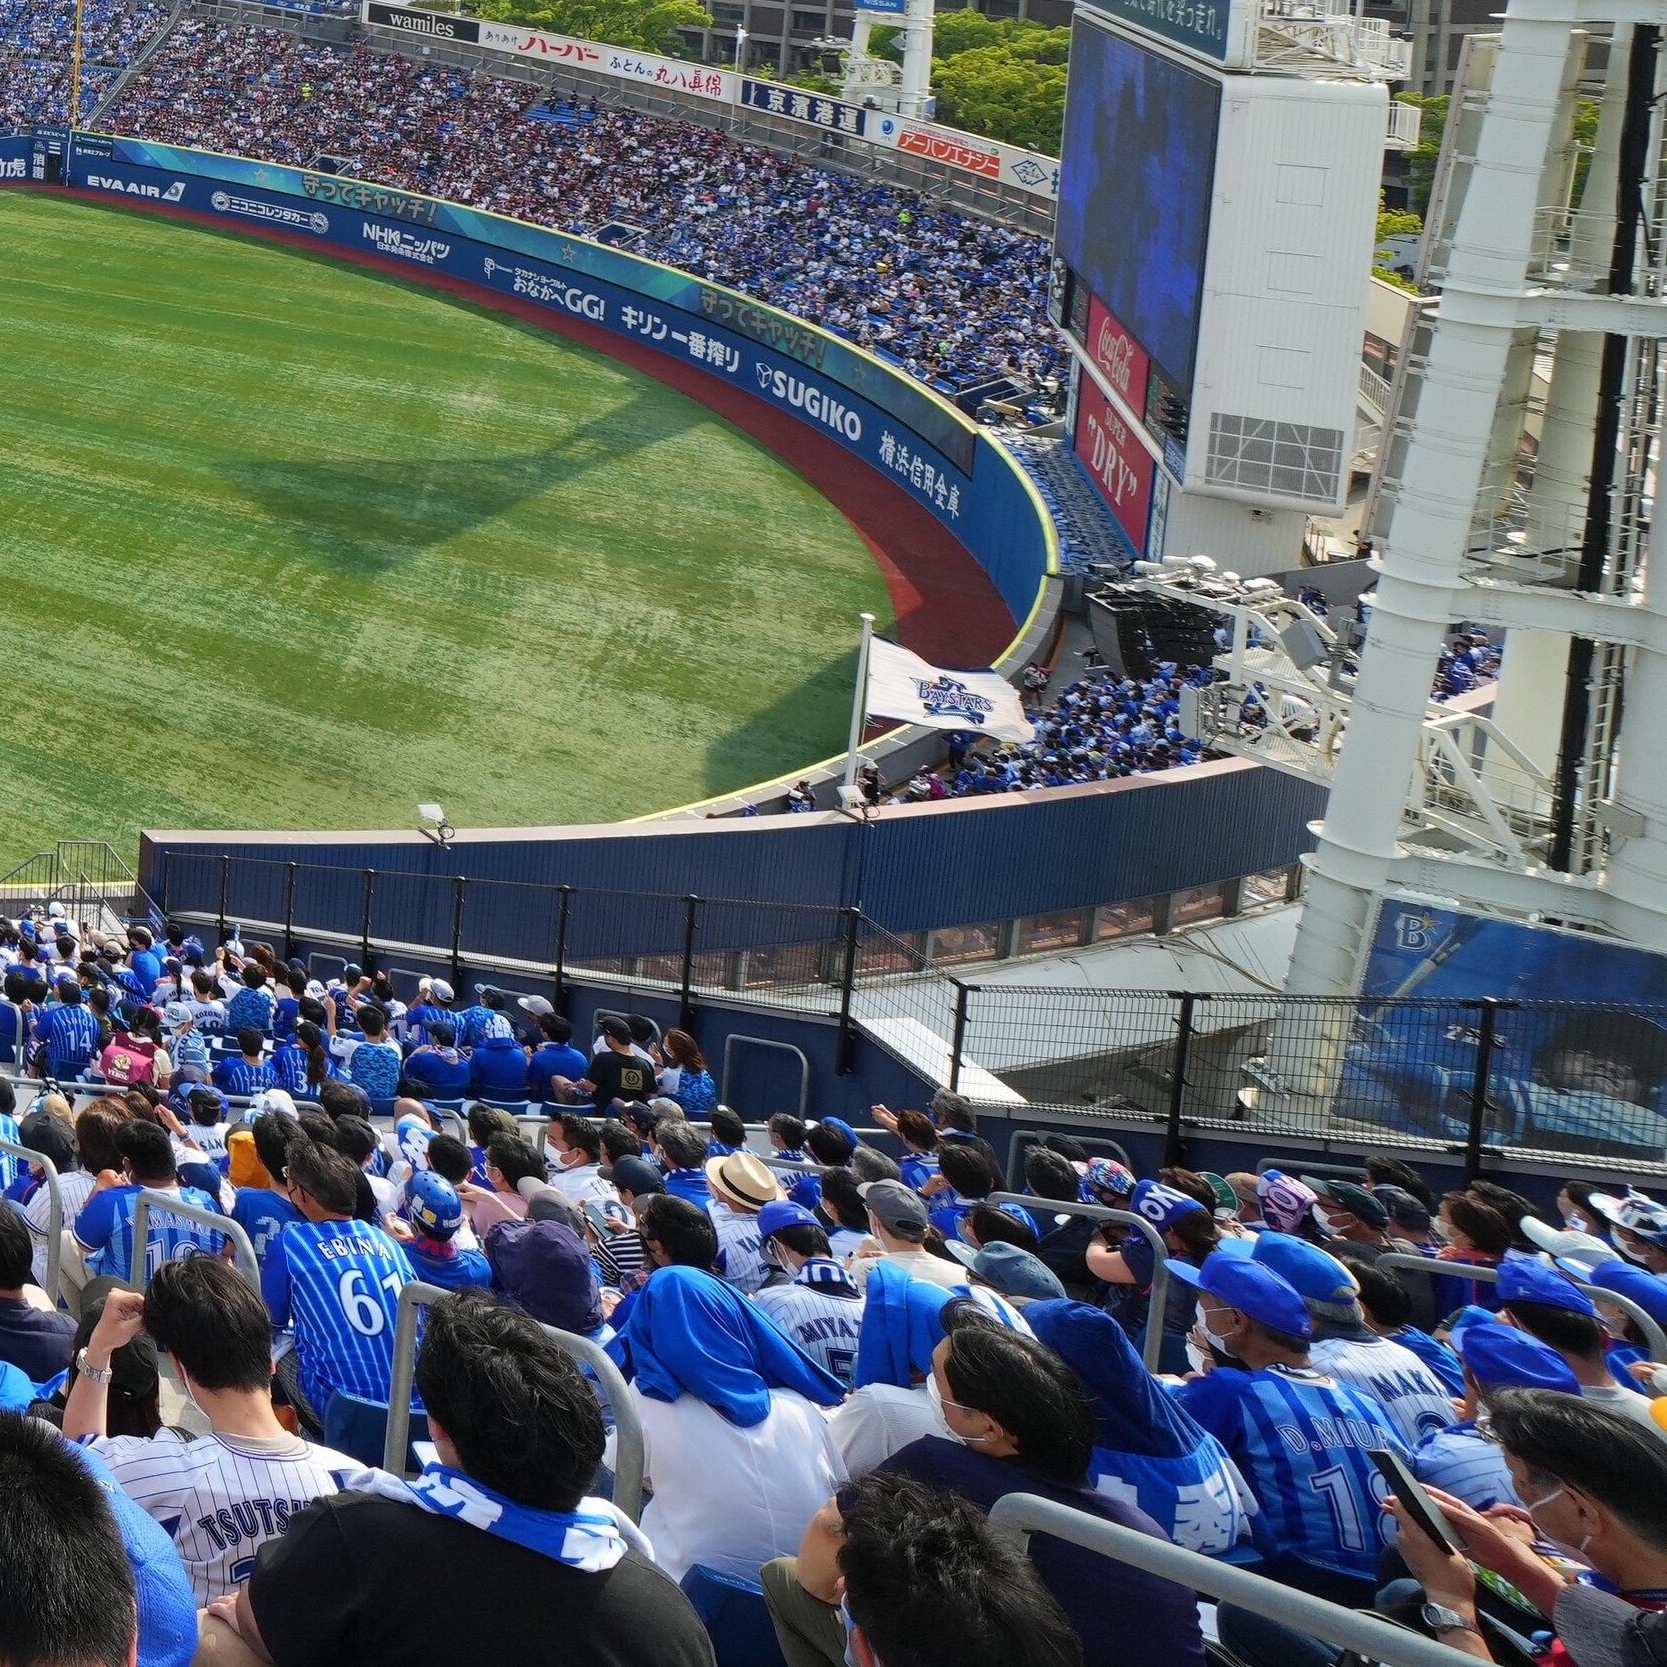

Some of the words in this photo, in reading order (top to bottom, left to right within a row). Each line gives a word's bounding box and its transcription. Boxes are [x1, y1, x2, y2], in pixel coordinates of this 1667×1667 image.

[388, 7, 457, 40] wamiles
[519, 34, 600, 64] ハーバー
[899, 132, 1000, 174] アーバンエナジー
[86, 174, 127, 193] EVA
[128, 181, 161, 199] AIR
[302, 174, 439, 225] 守ってキャッチ!
[230, 196, 310, 226] ニコニコレンタカー
[513, 275, 565, 307] おなかへ
[566, 287, 606, 323] GG!
[699, 287, 828, 368] 守ってキャッチ!
[1097, 313, 1132, 392] Coca-Cola
[771, 368, 863, 443] SUGIKO
[1103, 403, 1127, 449] SUPER
[877, 430, 962, 521] 横浜信用金庫
[917, 680, 994, 713] BAYSTARS
[66, 1030, 92, 1053] 14
[125, 1209, 211, 1237] YMASAKI
[316, 1237, 394, 1264] EBINA
